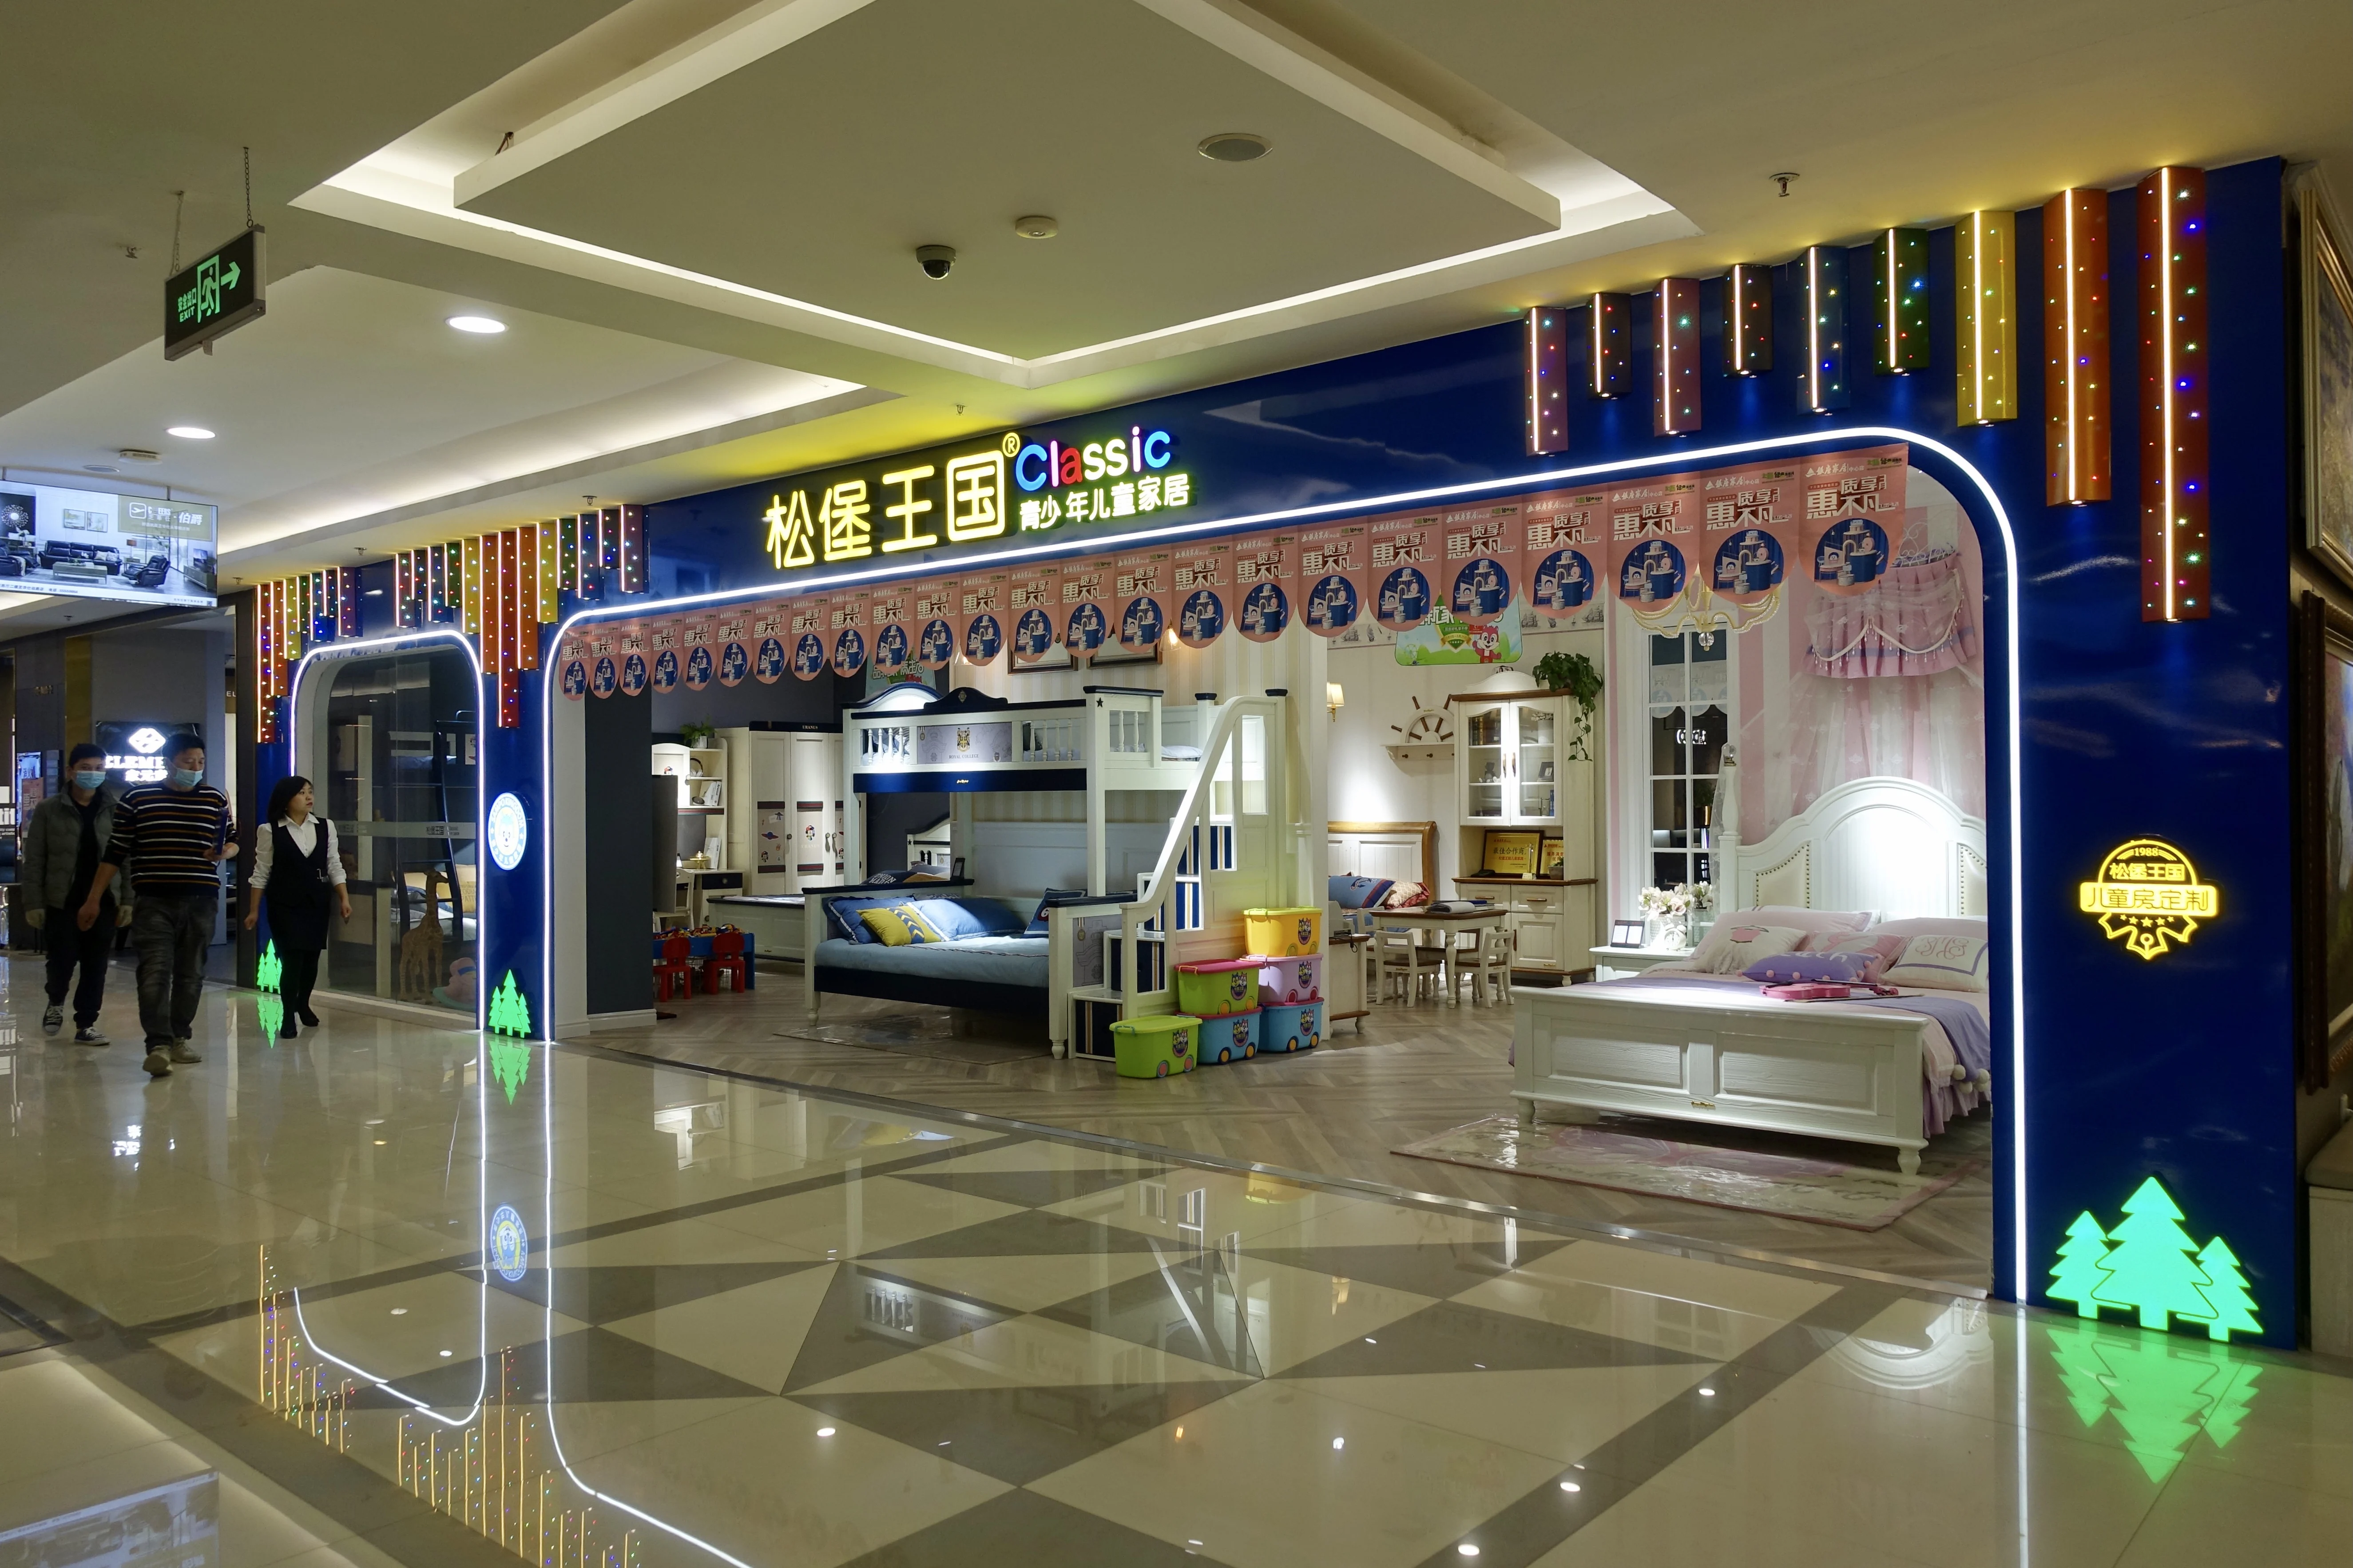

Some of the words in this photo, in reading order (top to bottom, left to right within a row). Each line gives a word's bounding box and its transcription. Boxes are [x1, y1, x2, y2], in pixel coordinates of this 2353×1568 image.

[178, 287, 196, 312] 安全出口
[179, 305, 195, 323] EXIT
[1016, 426, 1170, 491] Classic
[766, 450, 1006, 569] 松堡王国
[1020, 474, 1190, 531] 青少年儿童家居
[1806, 489, 1895, 519] 惠不凡
[1614, 513, 1690, 541] 惠不凡
[1706, 501, 1789, 530] 惠不凡
[1448, 534, 1513, 559] 惠不凡
[1528, 523, 1598, 550] 惠不凡
[1303, 551, 1360, 575] 惠不凡
[1373, 543, 1433, 567] 惠不凡
[1176, 568, 1226, 590] 惠不凡
[1238, 560, 1291, 583] 惠不凡
[1063, 582, 1108, 603] 惠不凡
[1117, 575, 1166, 597] 惠不凡
[918, 600, 956, 619] 惠不凡
[964, 594, 1003, 614] 惠不凡
[1012, 589, 1054, 609] 惠不凡
[792, 616, 824, 634] 惠不凡
[832, 610, 866, 629] 惠不凡
[874, 606, 909, 624] 惠不凡
[505, 797, 524, 828] KINGDOM
[2134, 847, 2159, 856] 1988
[873, 873, 897, 883] UNION
[2110, 863, 2186, 881] 松堡王国
[2087, 887, 2208, 911] 儿童房定制
